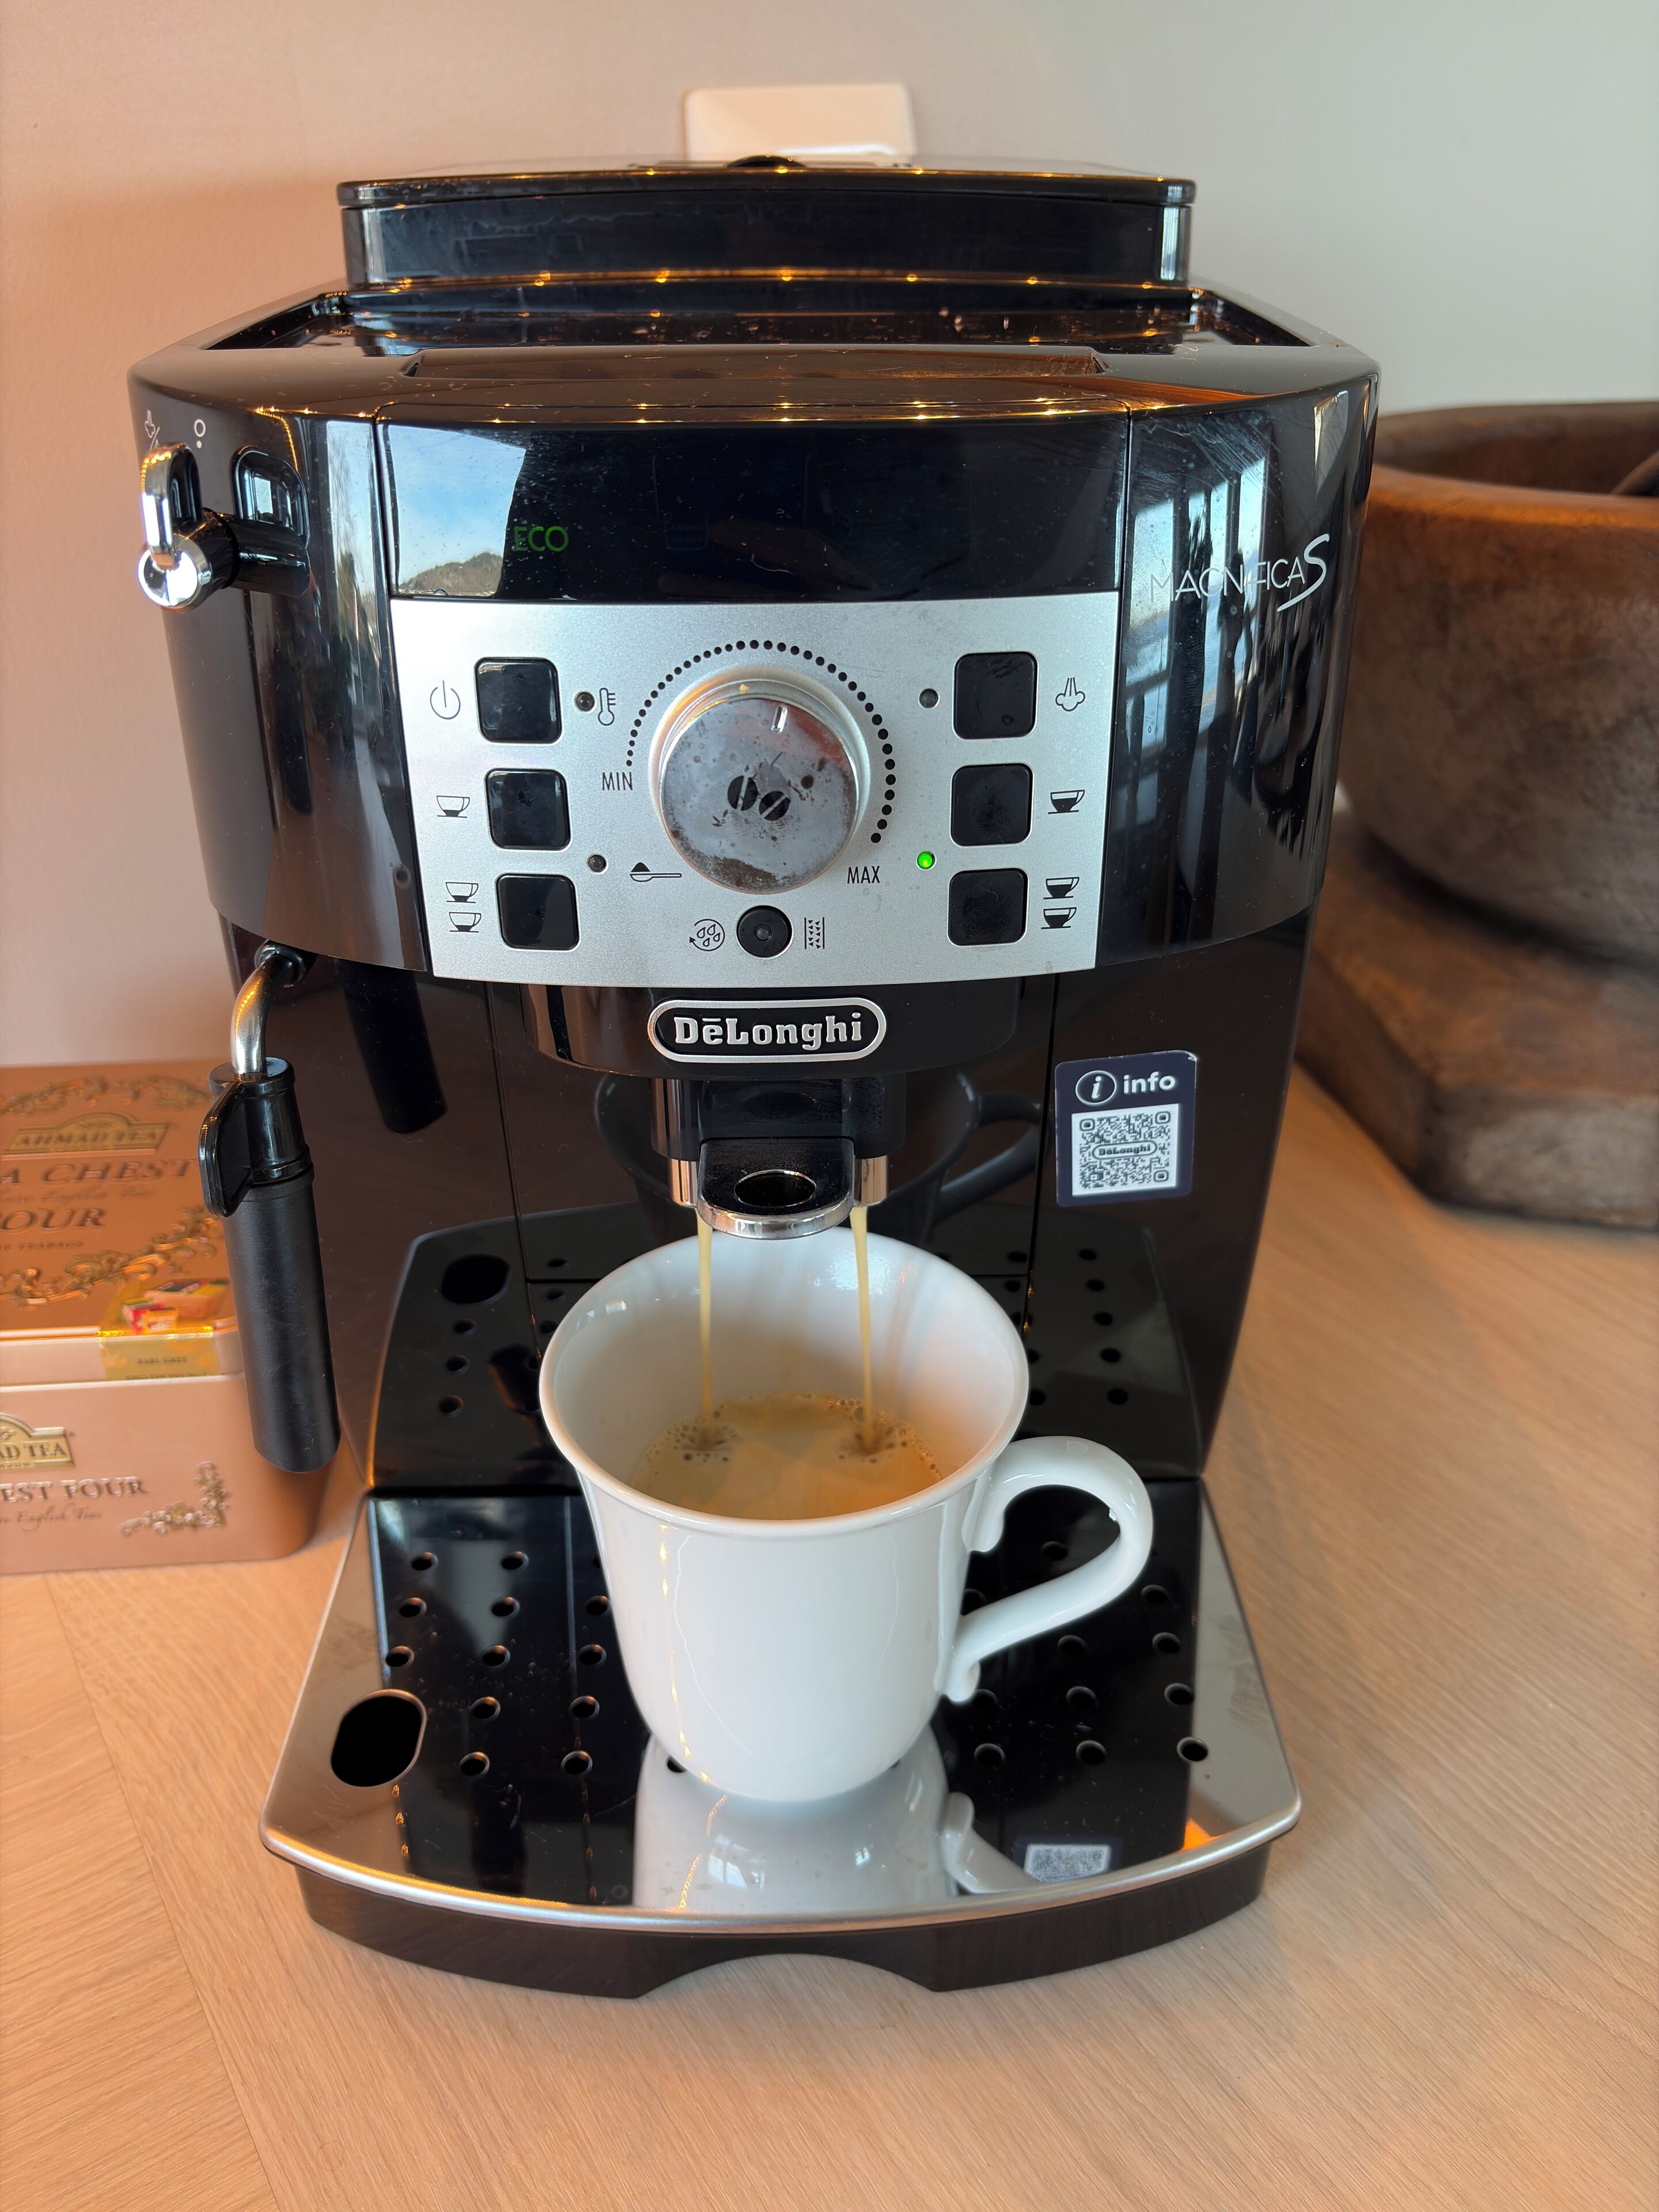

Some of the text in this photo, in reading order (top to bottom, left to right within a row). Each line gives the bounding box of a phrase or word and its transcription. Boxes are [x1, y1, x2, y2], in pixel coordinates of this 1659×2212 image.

[513, 526, 569, 551] ECO
[1151, 556, 1305, 603] MAGNFICA
[602, 772, 633, 791] MIN
[847, 866, 880, 884] MAX
[1123, 1071, 1175, 1094] info
[40, 1160, 198, 1183] CHEST
[0, 1207, 107, 1233] OUR
[23, 1441, 66, 1457] TEA
[60, 1476, 148, 1498] FOUR
